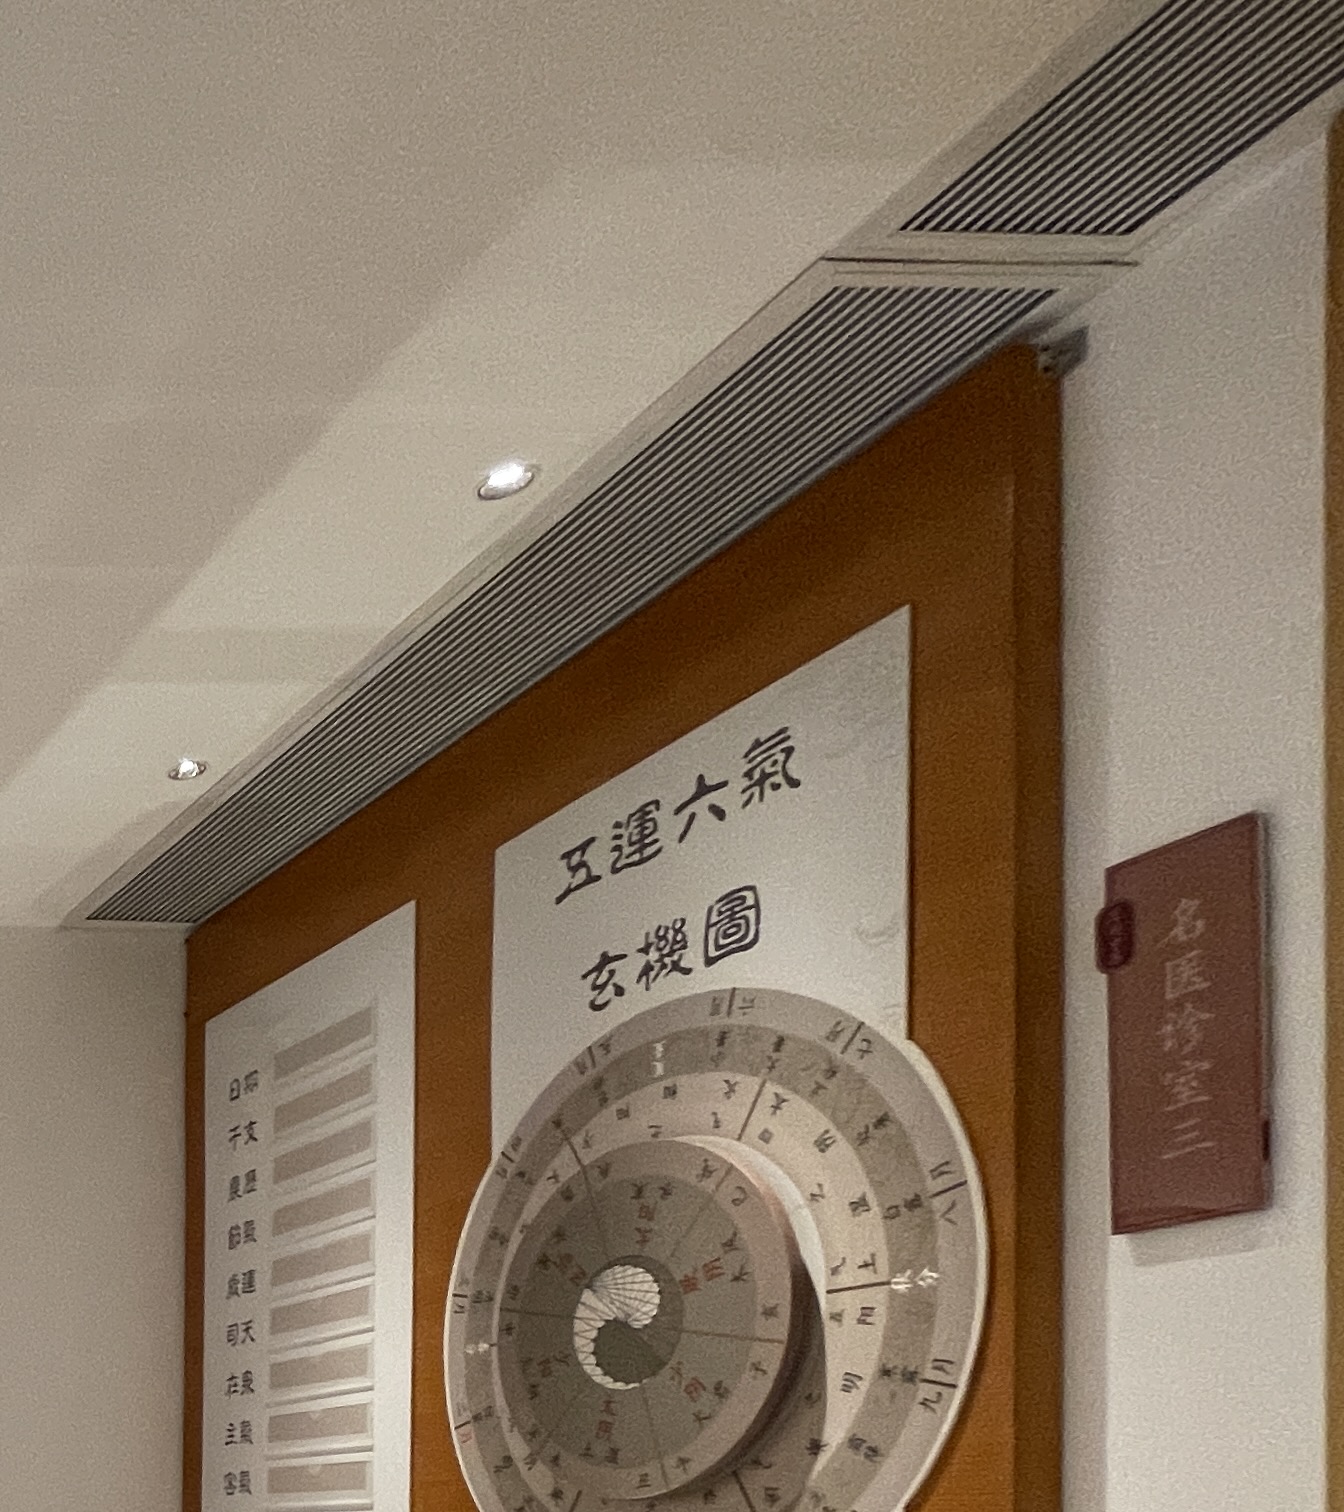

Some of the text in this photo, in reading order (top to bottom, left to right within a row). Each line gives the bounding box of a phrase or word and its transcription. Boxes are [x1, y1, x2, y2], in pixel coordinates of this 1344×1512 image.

[580, 884, 762, 1012] 玄機圖
[1155, 897, 1217, 1160] 名医诊室三
[226, 1319, 256, 1347] 司天
